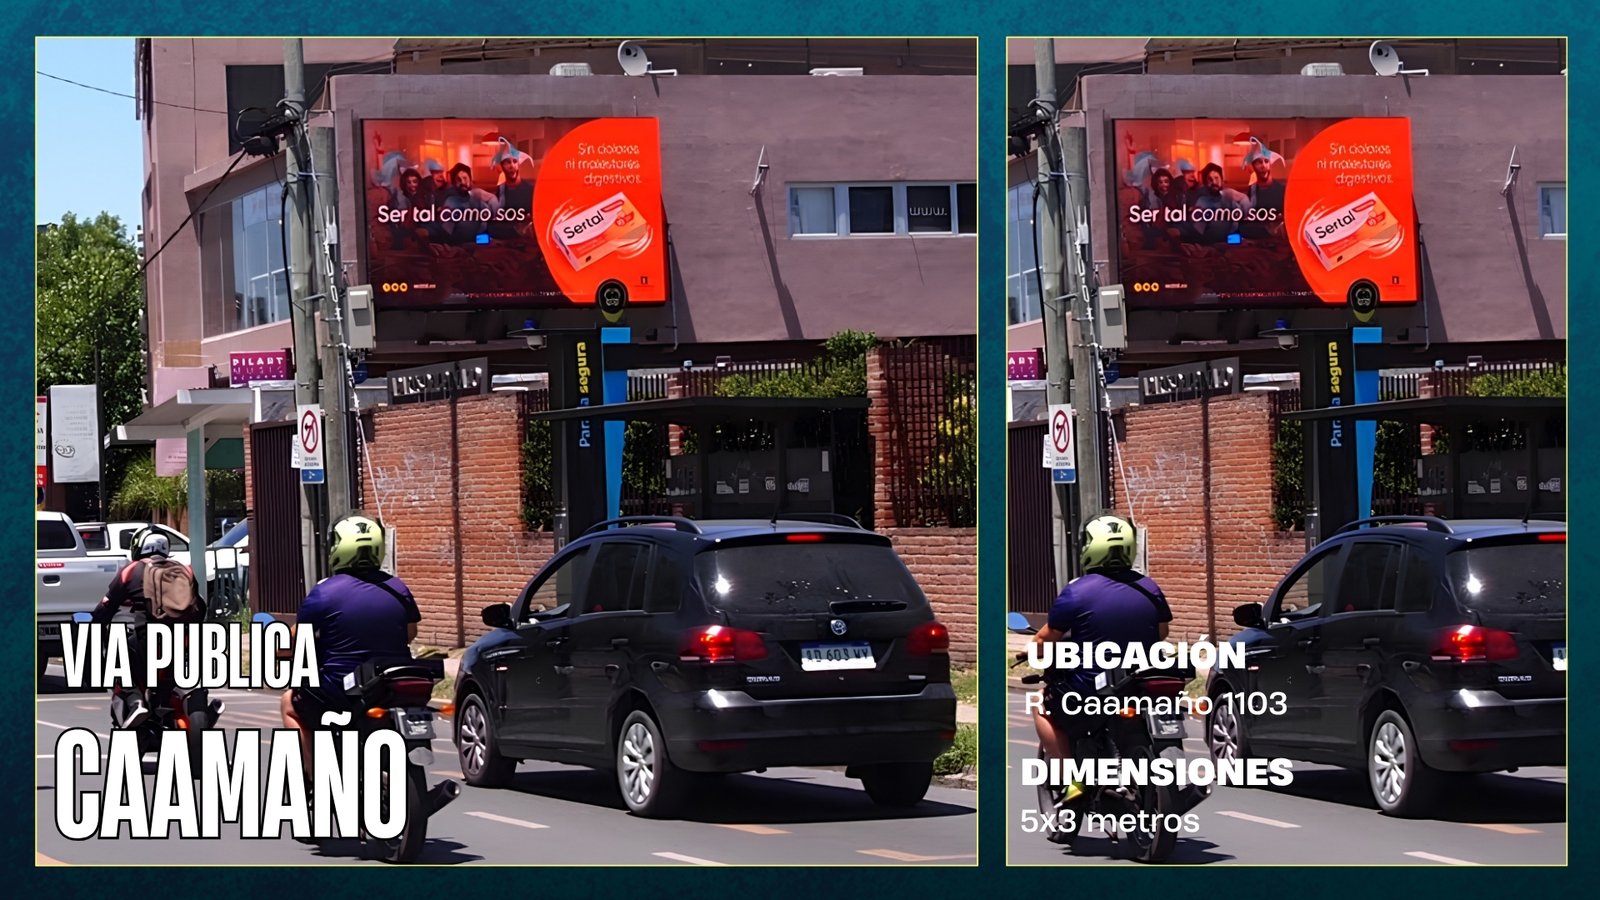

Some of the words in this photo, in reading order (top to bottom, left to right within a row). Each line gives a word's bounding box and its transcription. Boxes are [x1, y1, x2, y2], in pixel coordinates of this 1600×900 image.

[377, 205, 408, 223] Ser
[413, 204, 435, 222] tal
[440, 208, 491, 222] como
[497, 208, 526, 221] sos
[563, 210, 604, 239] Sertal
[1129, 205, 1159, 223] Ser
[1164, 204, 1187, 222] tal
[1191, 208, 1243, 222] como
[1248, 208, 1277, 221] sos
[1315, 210, 1356, 239] Sertal
[576, 341, 591, 394] segura
[1328, 341, 1343, 394] segura
